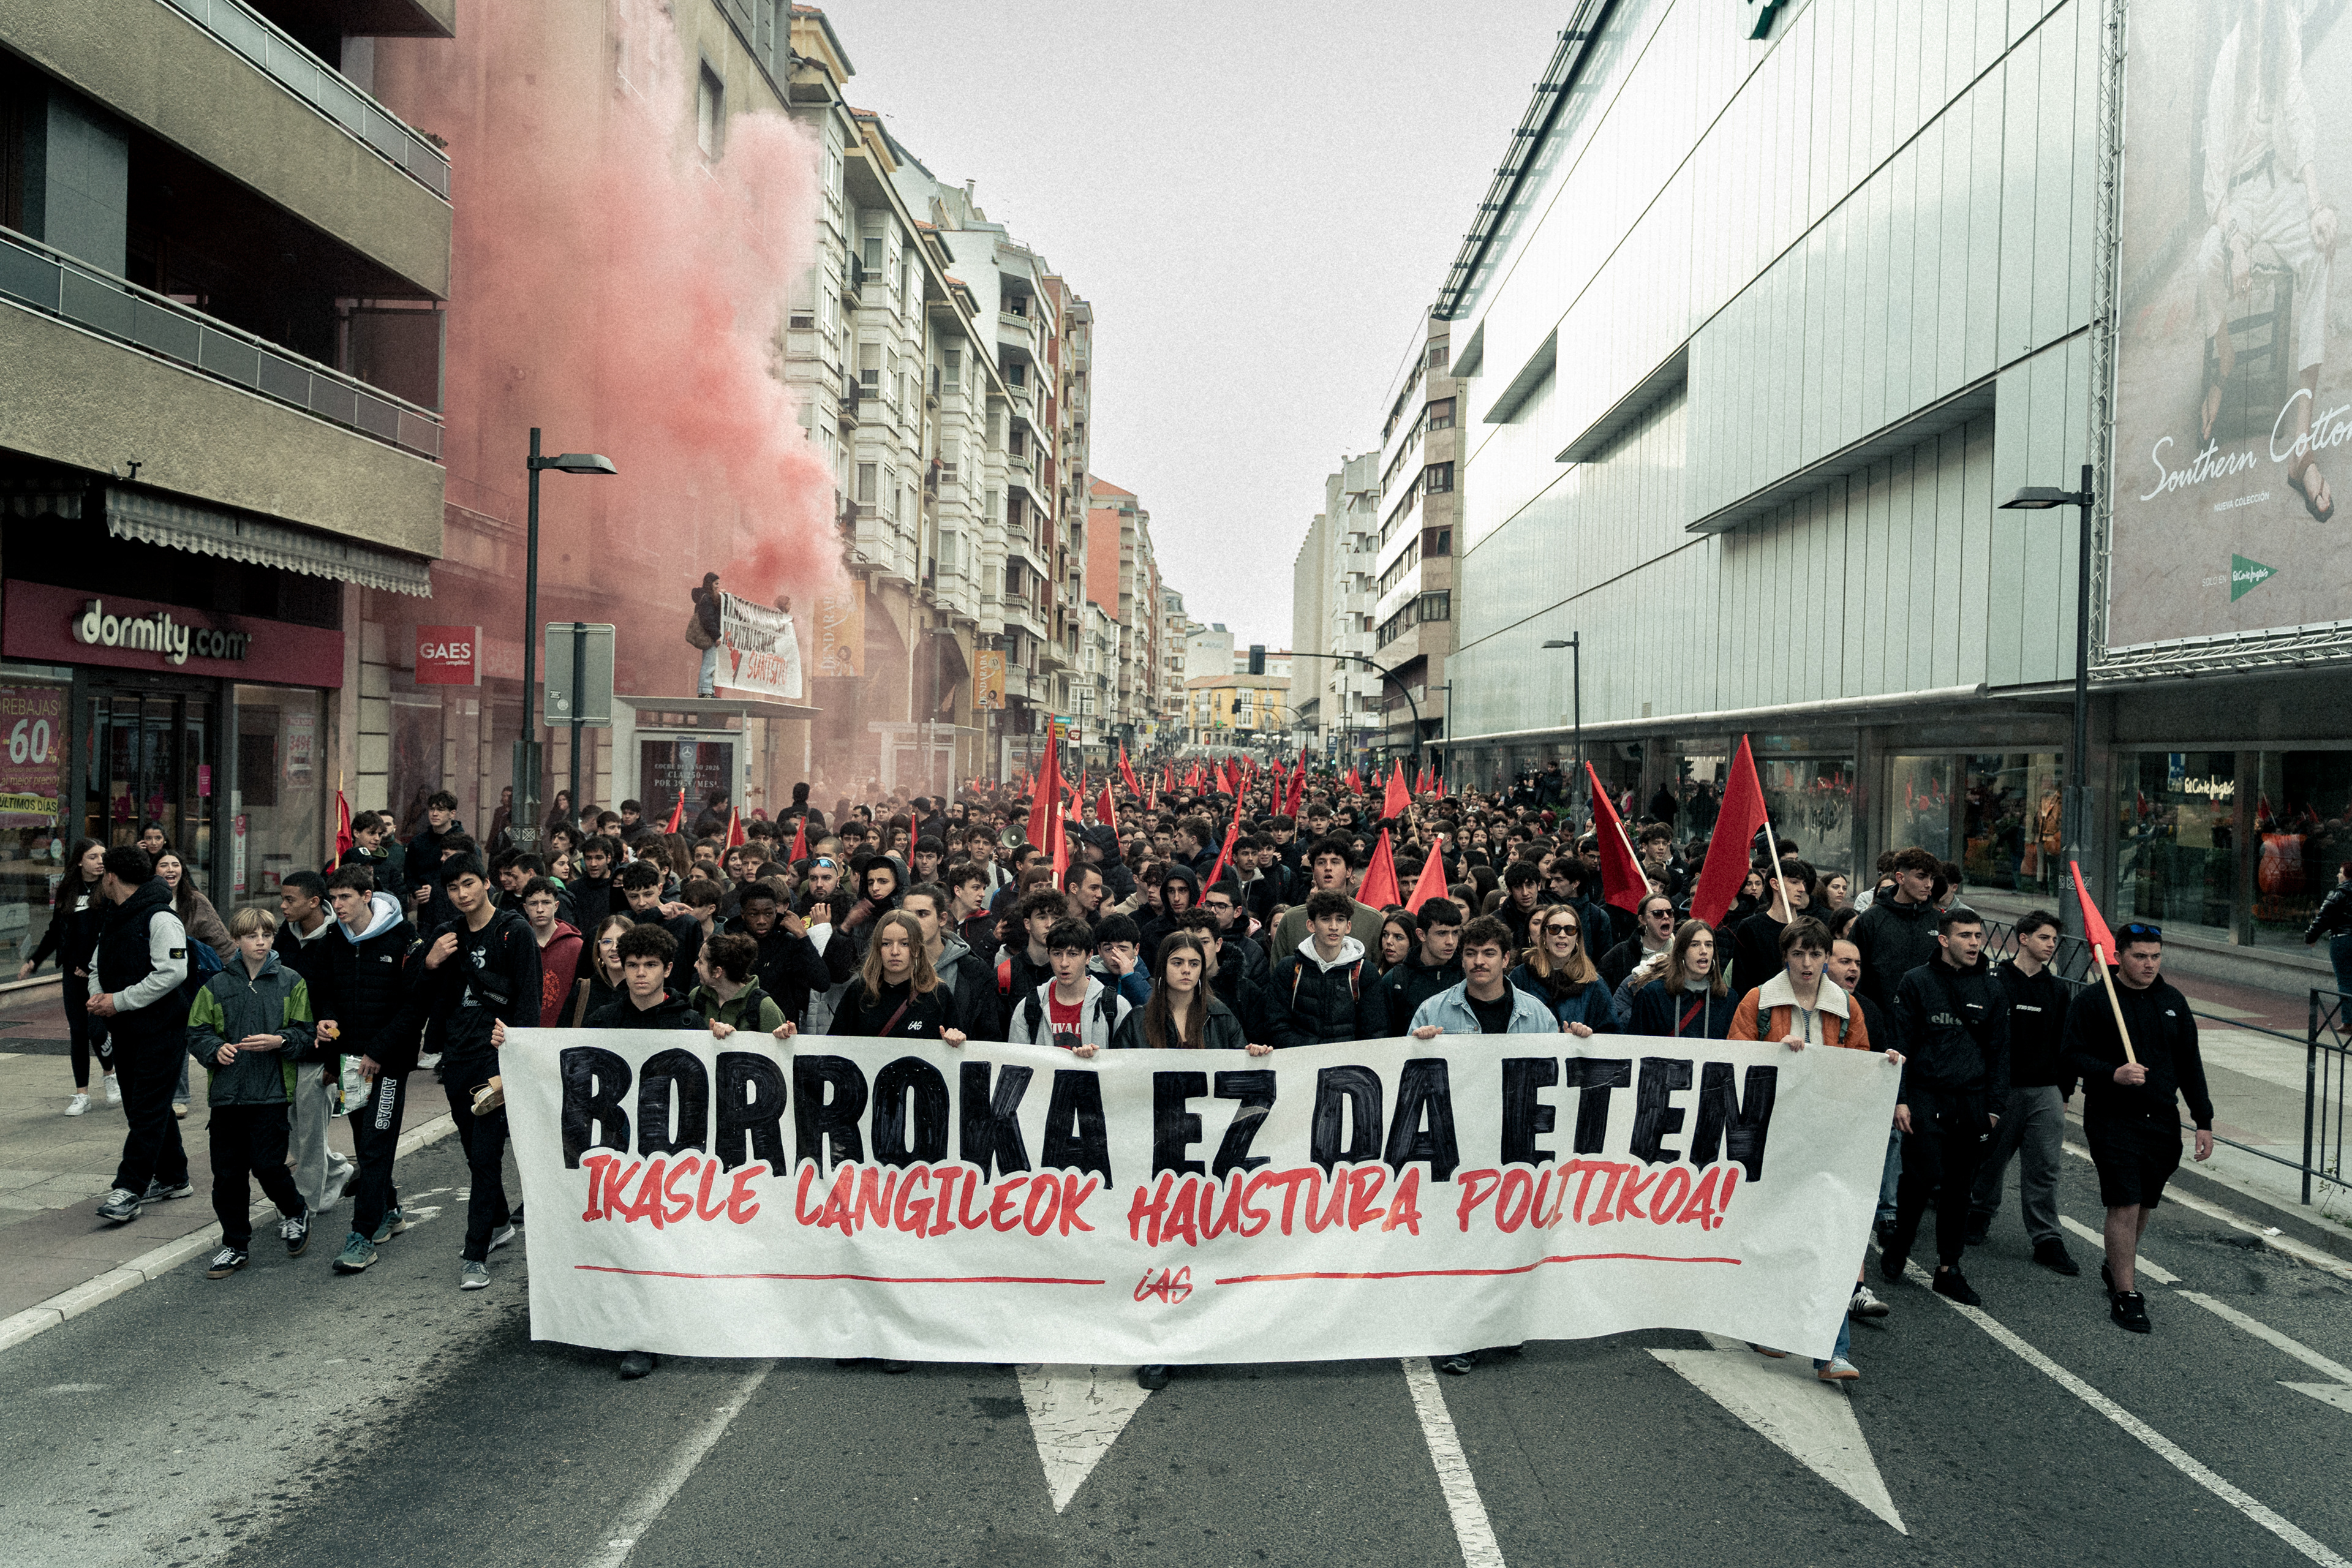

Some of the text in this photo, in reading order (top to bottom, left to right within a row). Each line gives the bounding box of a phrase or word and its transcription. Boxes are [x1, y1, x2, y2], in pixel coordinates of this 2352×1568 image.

[2140, 436, 2257, 501] Southern
[2214, 491, 2270, 513] NUEVA COLECCIÓN
[2202, 575, 2227, 587] SOLO EN
[82, 599, 246, 665] dormity.com
[821, 587, 837, 670] DENDARAB
[420, 643, 471, 659] GAES
[978, 654, 988, 706] DENDARABA
[2, 698, 58, 716] REBAJAS
[1, 774, 56, 788] al mejor precio
[654, 778, 671, 787] POR
[2184, 777, 2193, 794] El
[2193, 778, 2210, 794] Corte
[0, 794, 57, 812] ÚLTIMOS DÍAS
[77, 895, 90, 907] NIK
[375, 1077, 397, 1129] ADIDAS
[560, 1046, 1779, 1192] BORROKA EZ DA ETEN
[582, 1154, 1739, 1247] IKASLE LANGILEOK HAUSTURA POLITIKOA!
